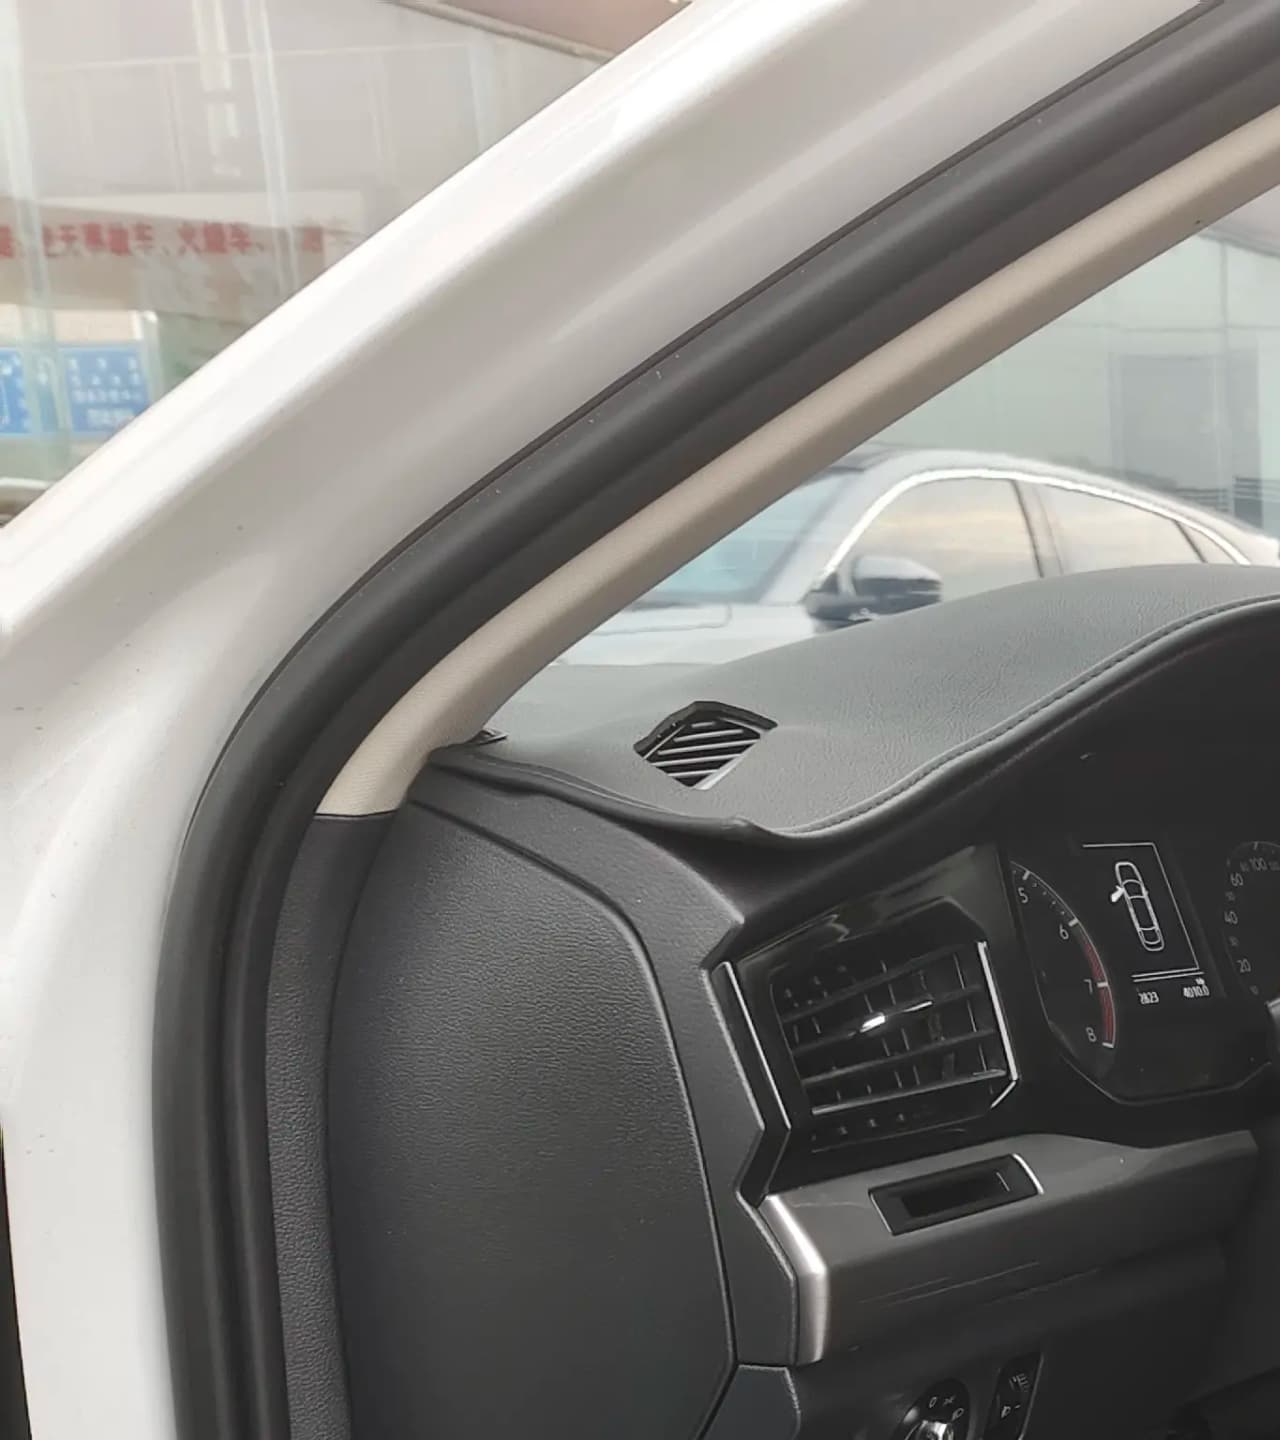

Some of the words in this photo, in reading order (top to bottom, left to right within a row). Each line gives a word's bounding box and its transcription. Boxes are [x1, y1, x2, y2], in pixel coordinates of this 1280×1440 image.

[1018, 888, 1029, 904] 5
[1059, 925, 1069, 940] 6
[1084, 978, 1093, 994] 7
[1086, 1028, 1097, 1043] 8
